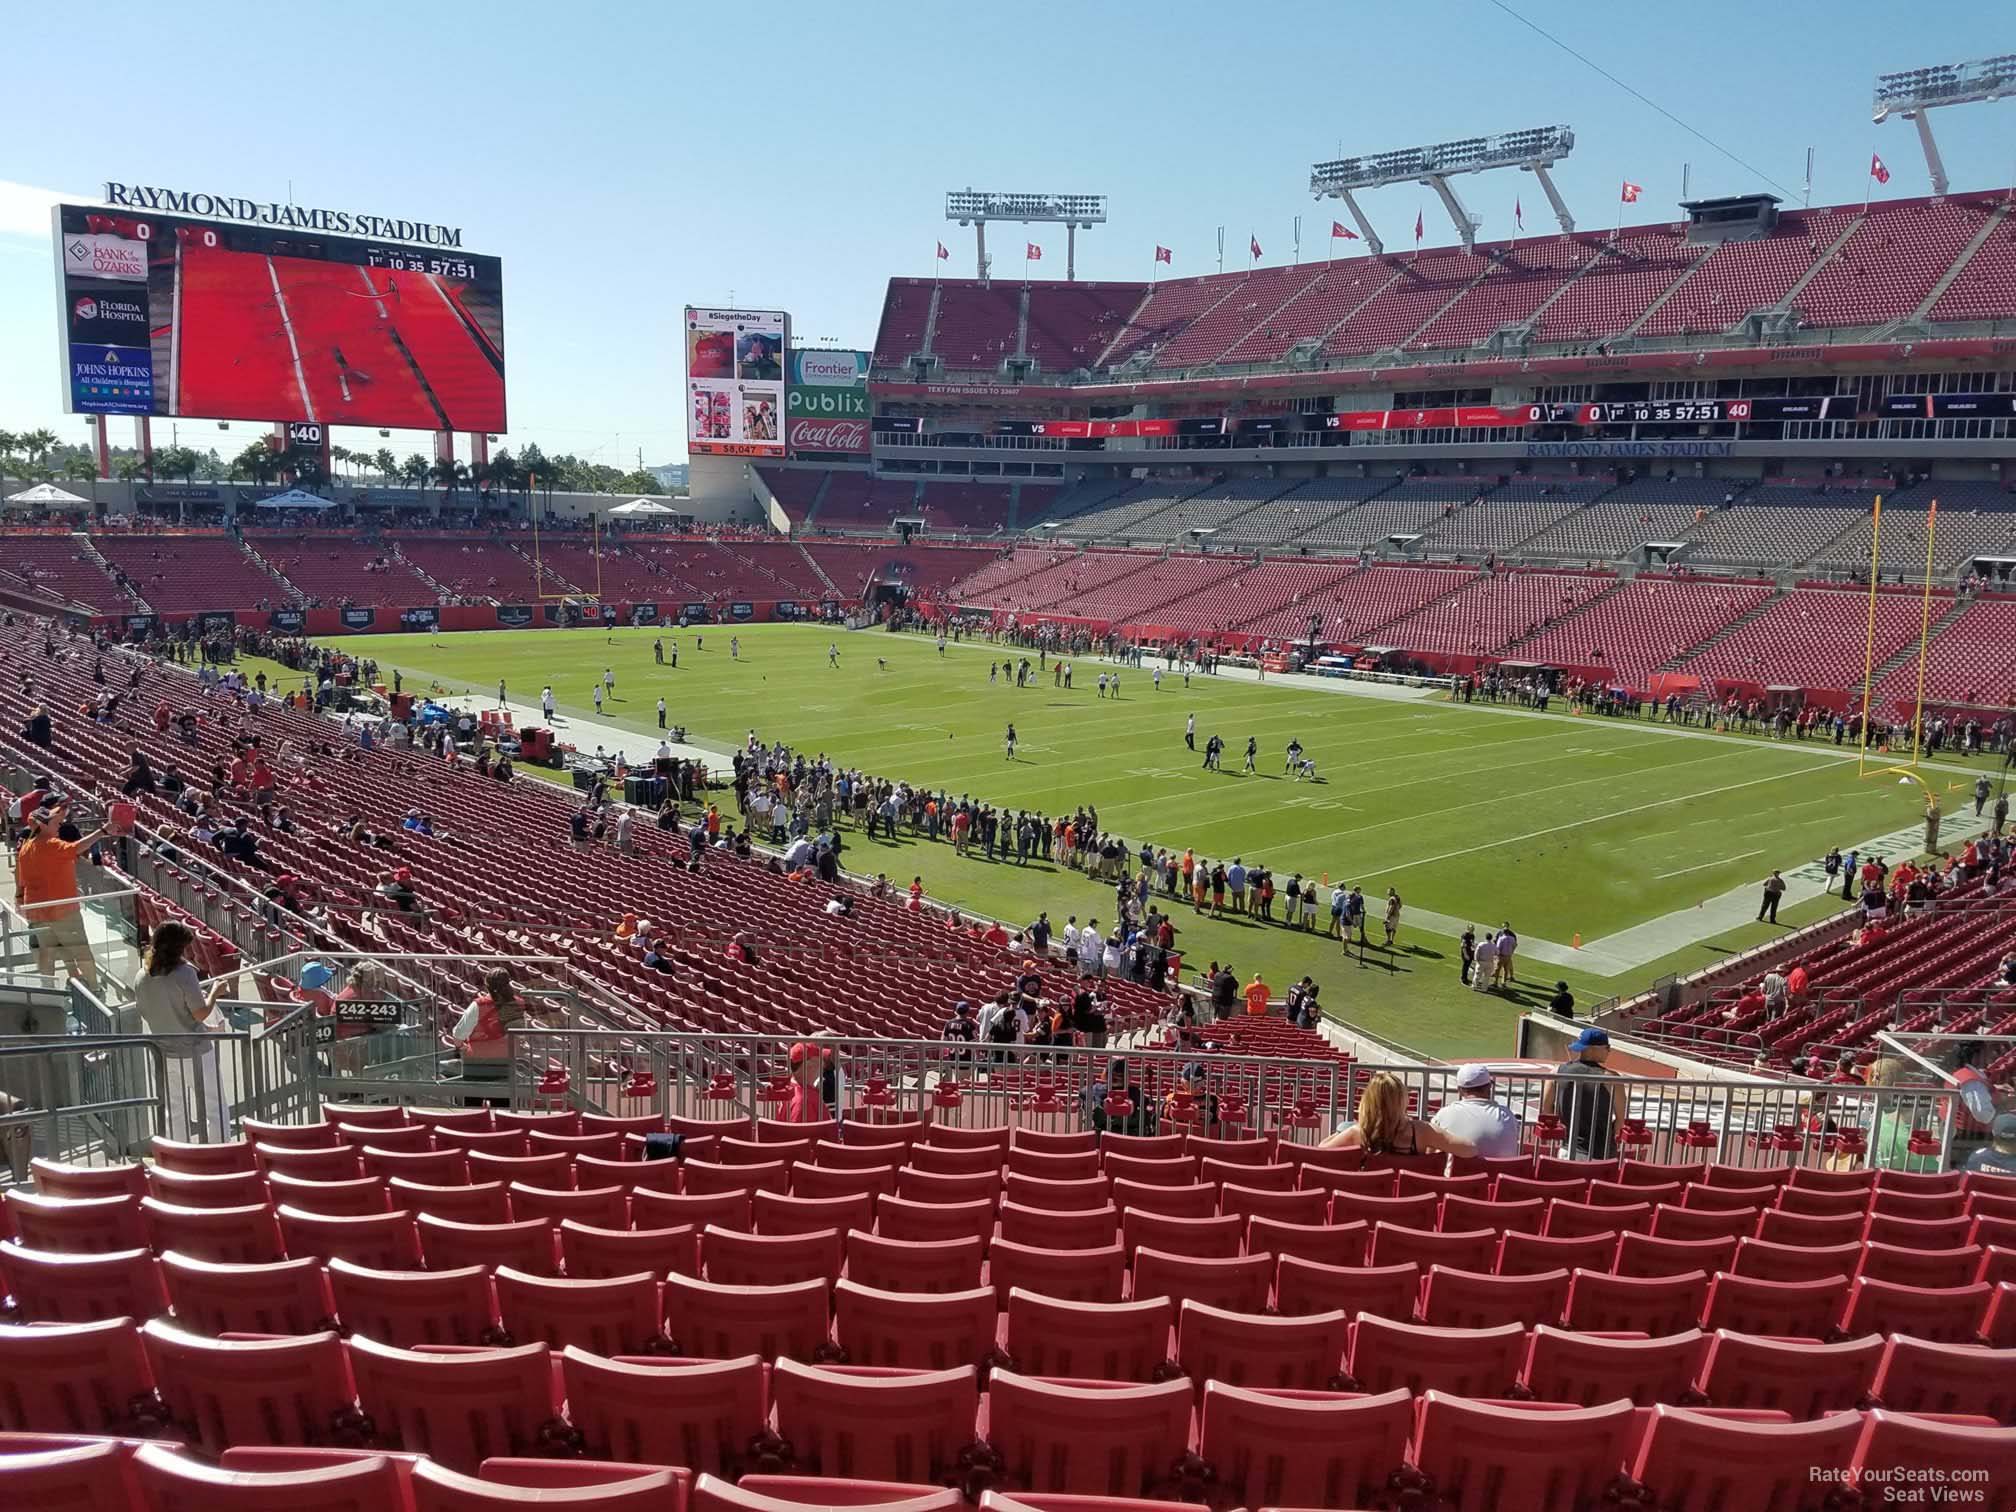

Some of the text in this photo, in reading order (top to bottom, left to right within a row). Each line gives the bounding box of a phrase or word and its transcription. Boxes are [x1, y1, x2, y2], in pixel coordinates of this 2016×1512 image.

[107, 182, 462, 247] RAYMOND JAMES STADIUM
[137, 224, 150, 239] 0
[204, 231, 217, 247] 0
[94, 247, 128, 261] BANK
[93, 258, 142, 275] OZARKS
[388, 258, 404, 270] 10
[408, 260, 425, 272] 35
[431, 260, 475, 278] 57:51
[100, 300, 140, 312] FLORIDA
[100, 309, 146, 321] HOSPITAL
[708, 312, 761, 323] #SiegetheDay
[76, 363, 150, 377] JOHNS HOPKINS
[805, 361, 853, 375] Frontier
[788, 391, 865, 413] Publix
[1529, 406, 1540, 420] 0
[1589, 406, 1600, 420] 0
[1635, 409, 1648, 419] 10
[1655, 409, 1670, 419] 35
[1675, 406, 1719, 419] 57:51
[1729, 404, 1747, 416] 40
[1031, 424, 1045, 433] VS
[1326, 417, 1339, 427] VS
[297, 426, 320, 441] 40
[1527, 442, 1730, 457] RAYMOND JAMES STADIUM
[583, 607, 597, 617] 40
[339, 1004, 397, 1016] 242-243
